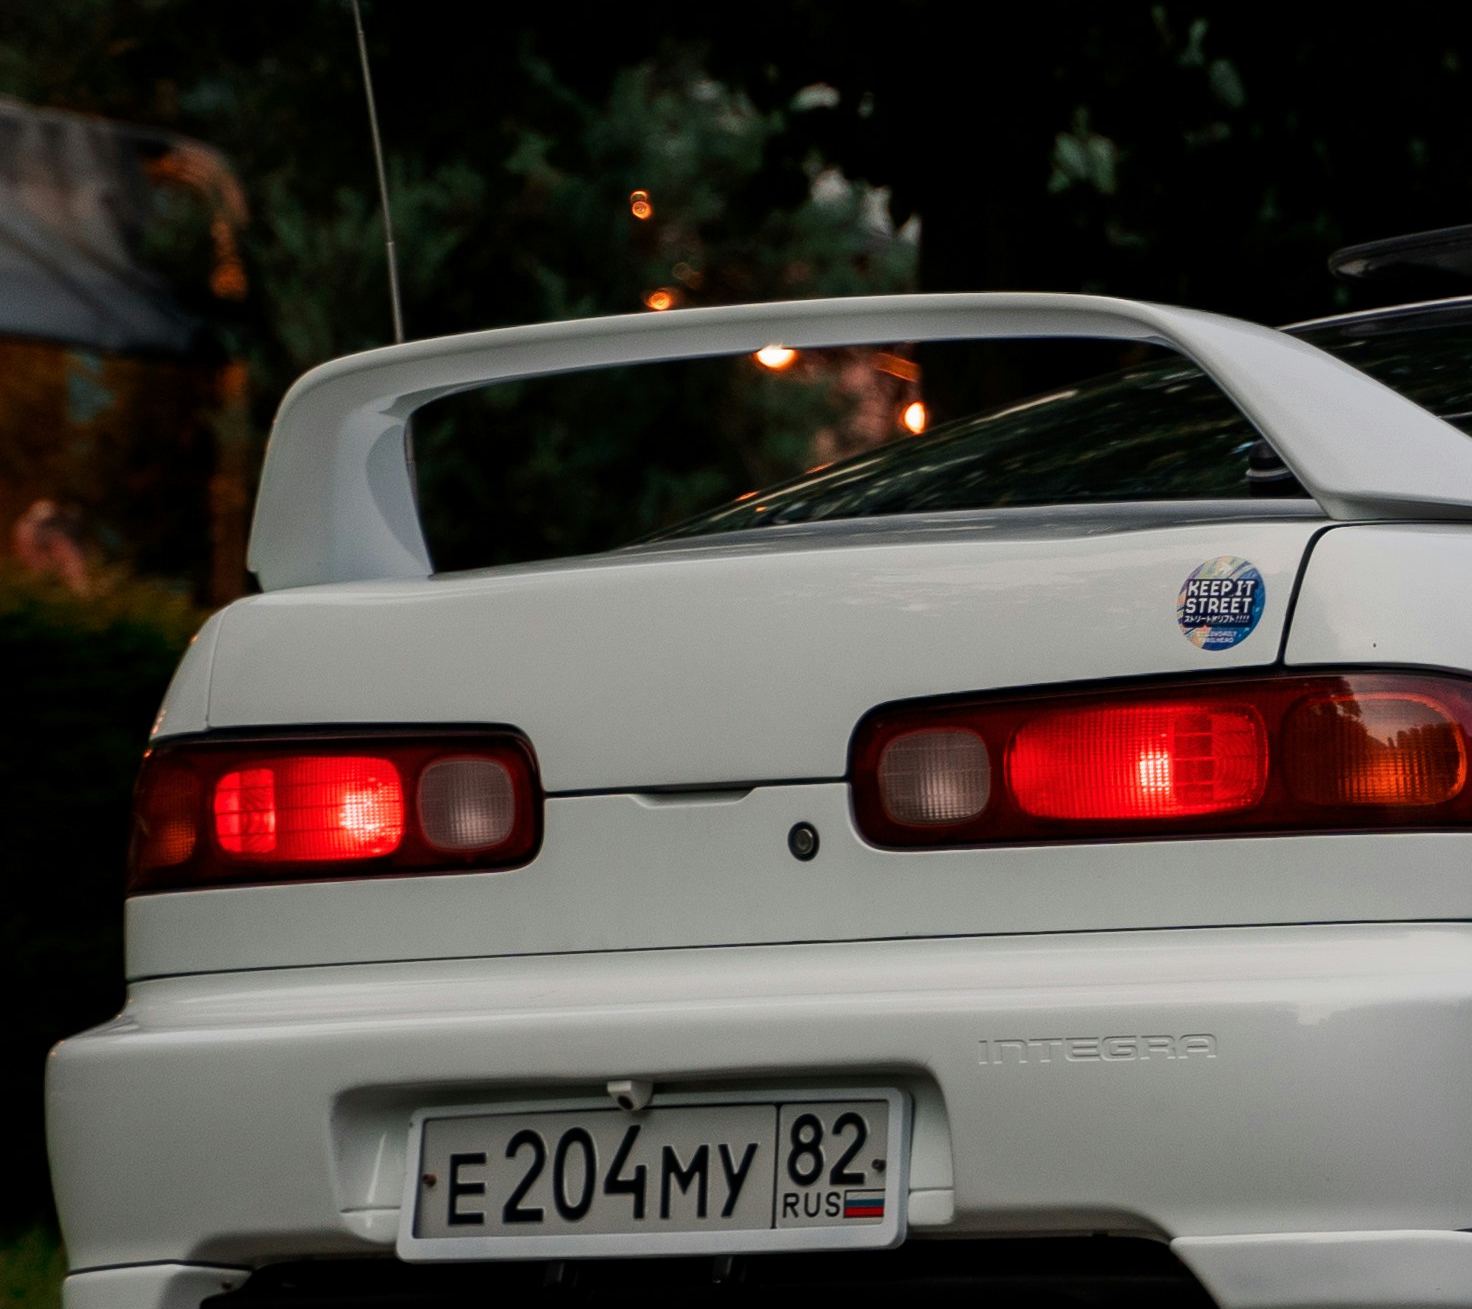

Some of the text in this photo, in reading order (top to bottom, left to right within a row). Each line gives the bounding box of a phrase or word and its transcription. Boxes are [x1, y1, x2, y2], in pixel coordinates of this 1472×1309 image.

[1187, 579, 1255, 597] KEEP IT
[1185, 597, 1253, 614] STREET
[978, 1033, 1218, 1065] INTEGRA
[786, 1112, 868, 1187] 82
[782, 1192, 841, 1219] RUS
